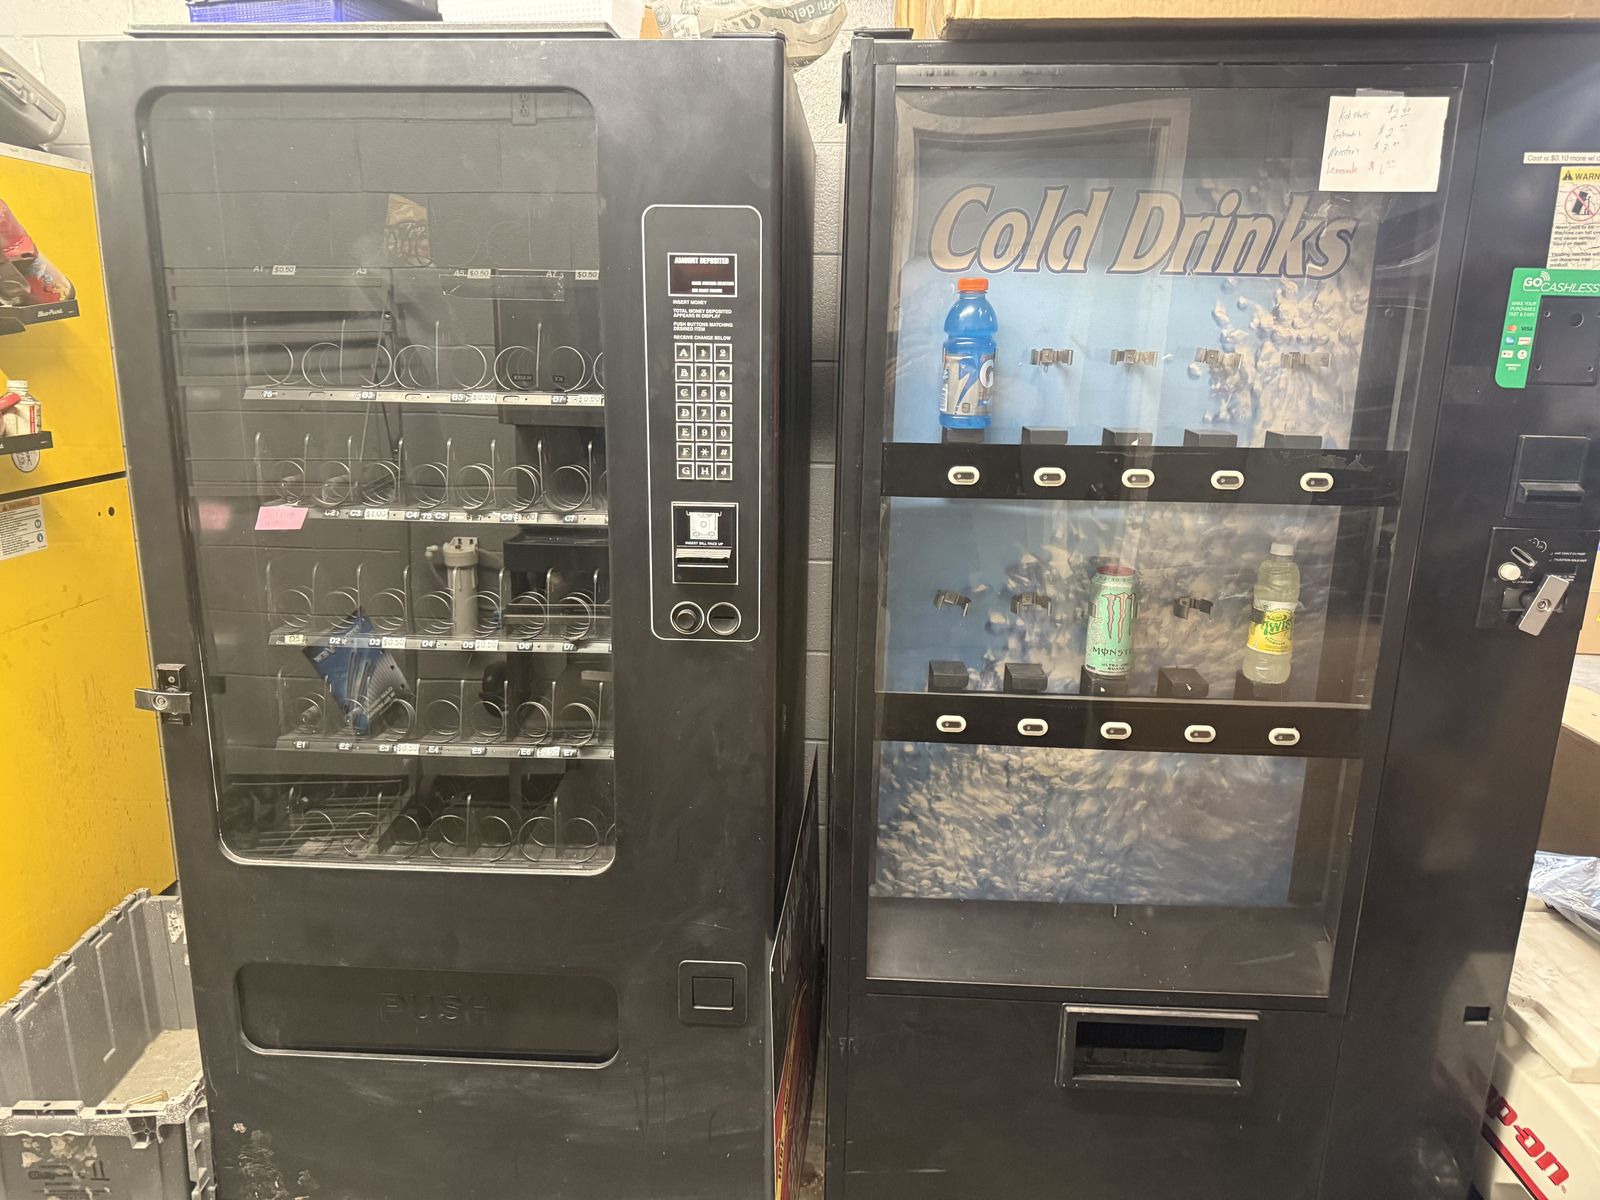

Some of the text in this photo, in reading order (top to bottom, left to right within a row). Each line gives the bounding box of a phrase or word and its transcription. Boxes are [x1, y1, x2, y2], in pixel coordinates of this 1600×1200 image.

[1550, 154, 1569, 162] $0.10
[928, 183, 1359, 280] Cold Drinks
[1524, 277, 1600, 293] GO CASHLESS
[679, 348, 726, 357] A 1 2
[680, 368, 726, 377] B 3 4
[680, 388, 727, 397] C 5 6
[681, 408, 727, 417] D 7 8
[681, 427, 727, 437] E 9 0
[681, 447, 728, 456] F #
[681, 466, 727, 476] G H J
[406, 511, 418, 519] C4
[329, 637, 341, 645] D2
[422, 640, 433, 648] D4
[462, 641, 474, 649] D5
[379, 744, 390, 752] E3
[564, 748, 574, 757] E7
[378, 992, 490, 1025] PUSH
